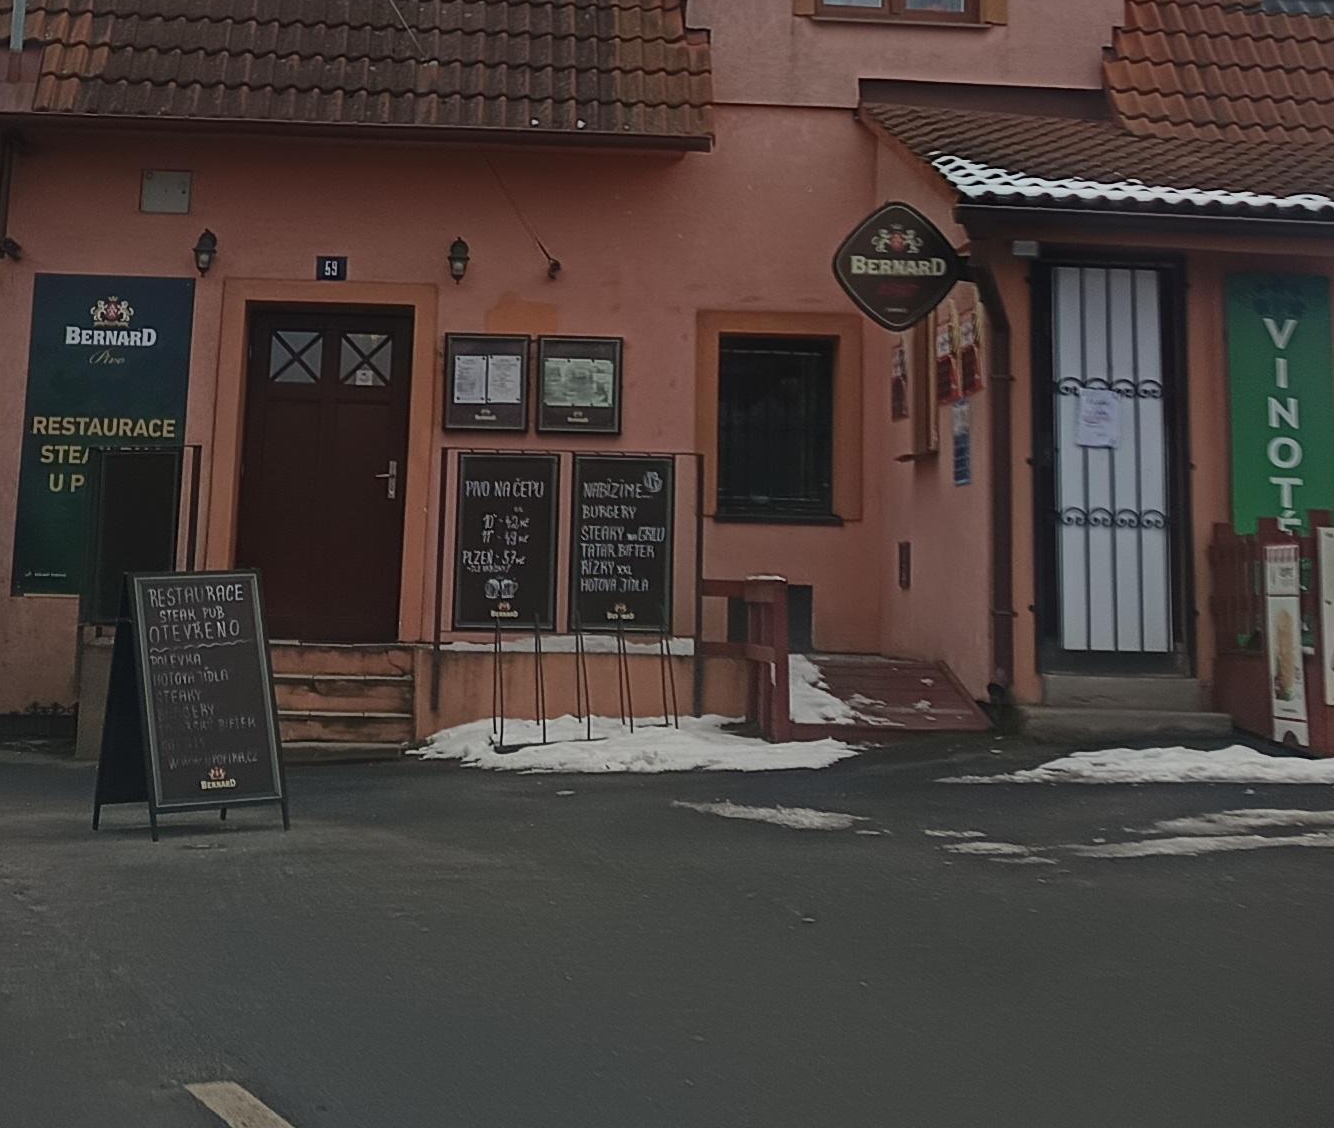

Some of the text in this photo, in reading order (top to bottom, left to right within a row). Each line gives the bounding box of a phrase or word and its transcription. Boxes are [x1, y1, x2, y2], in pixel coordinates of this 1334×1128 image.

[324, 260, 338, 276] 59
[850, 255, 947, 276] BERNARD
[65, 326, 157, 347] BERNARD
[32, 416, 176, 438] RESTAURACE
[493, 480, 510, 498] NA
[582, 504, 637, 519] BURGERY
[148, 583, 244, 608] RESTAURACE
[201, 605, 225, 620] PUB
[200, 779, 236, 790] BERNARD
